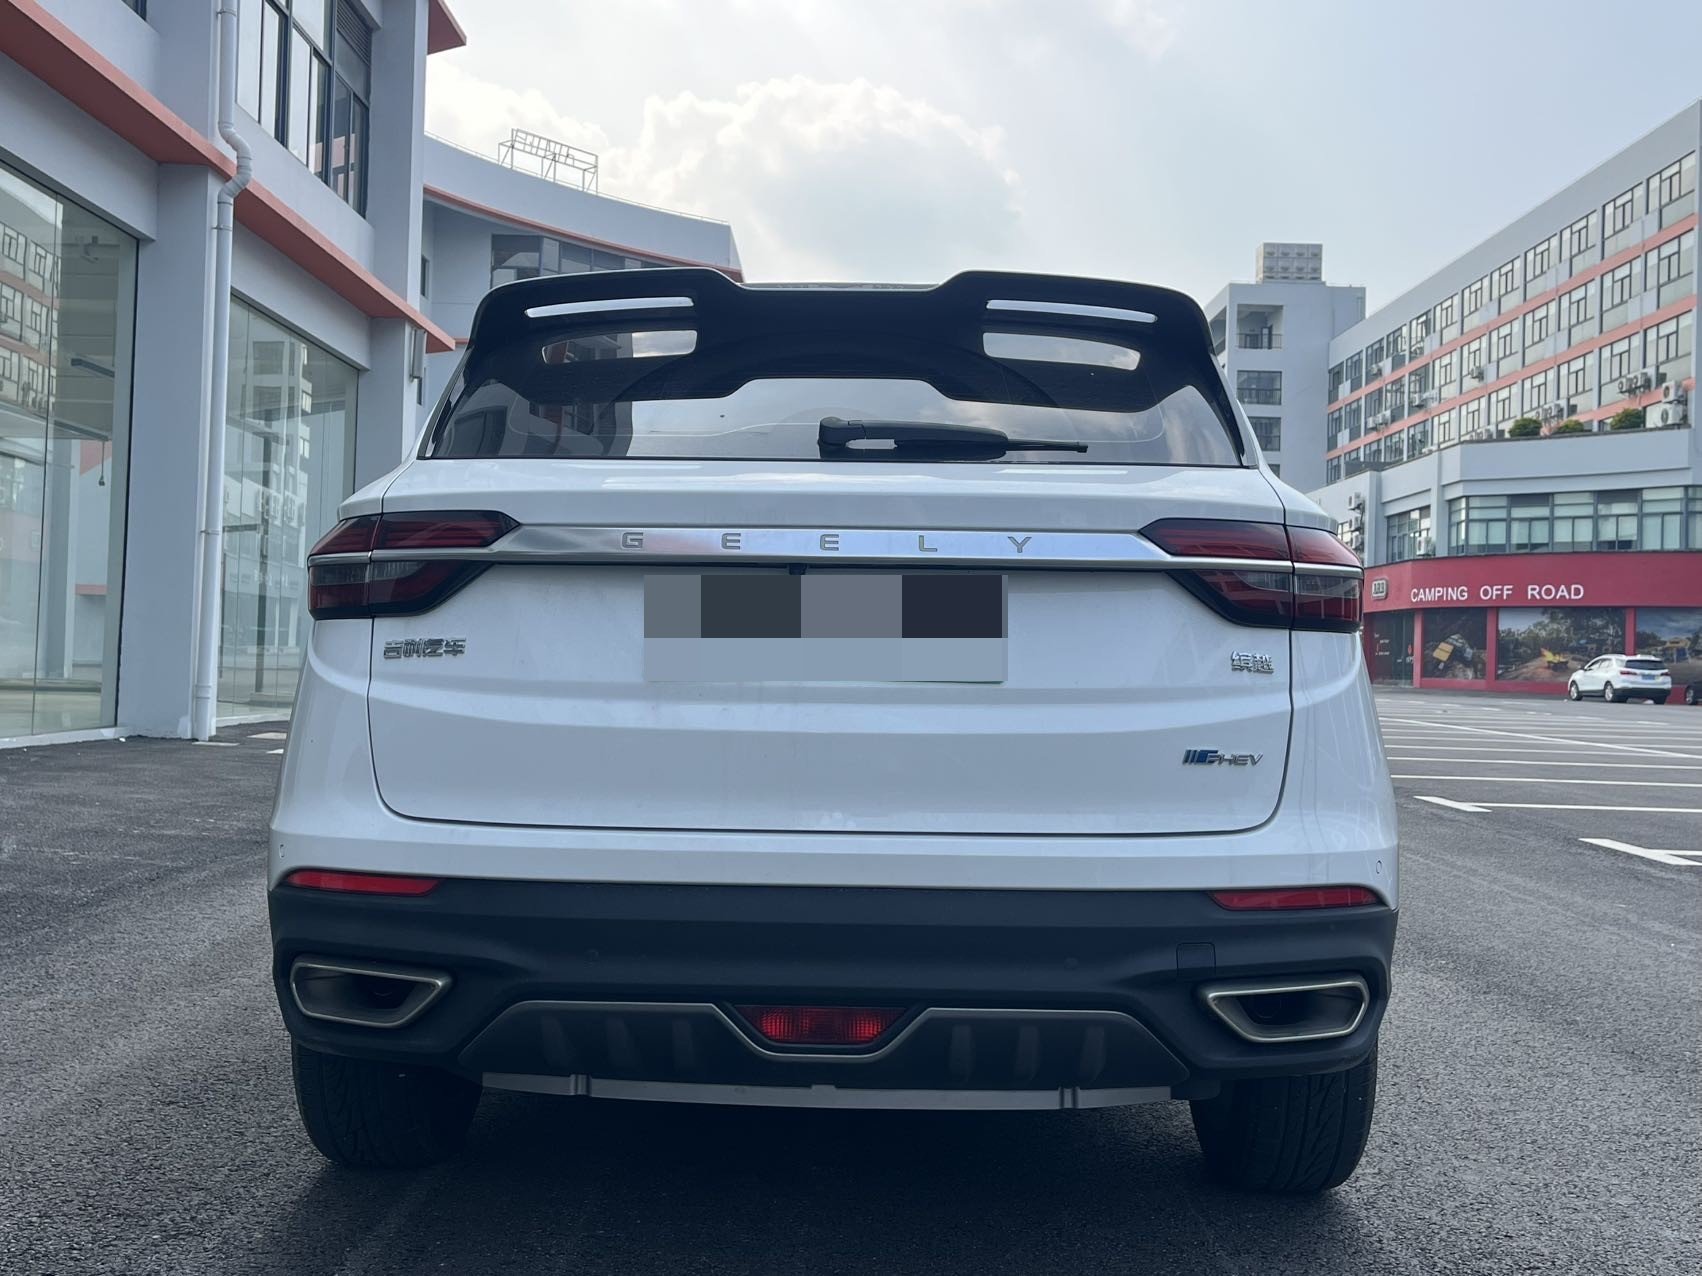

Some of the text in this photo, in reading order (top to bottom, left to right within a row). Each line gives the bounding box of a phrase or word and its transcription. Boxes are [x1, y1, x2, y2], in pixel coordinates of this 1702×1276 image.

[621, 532, 1032, 553] GEELY
[1410, 584, 1585, 602] CAMPING OFF ROAD
